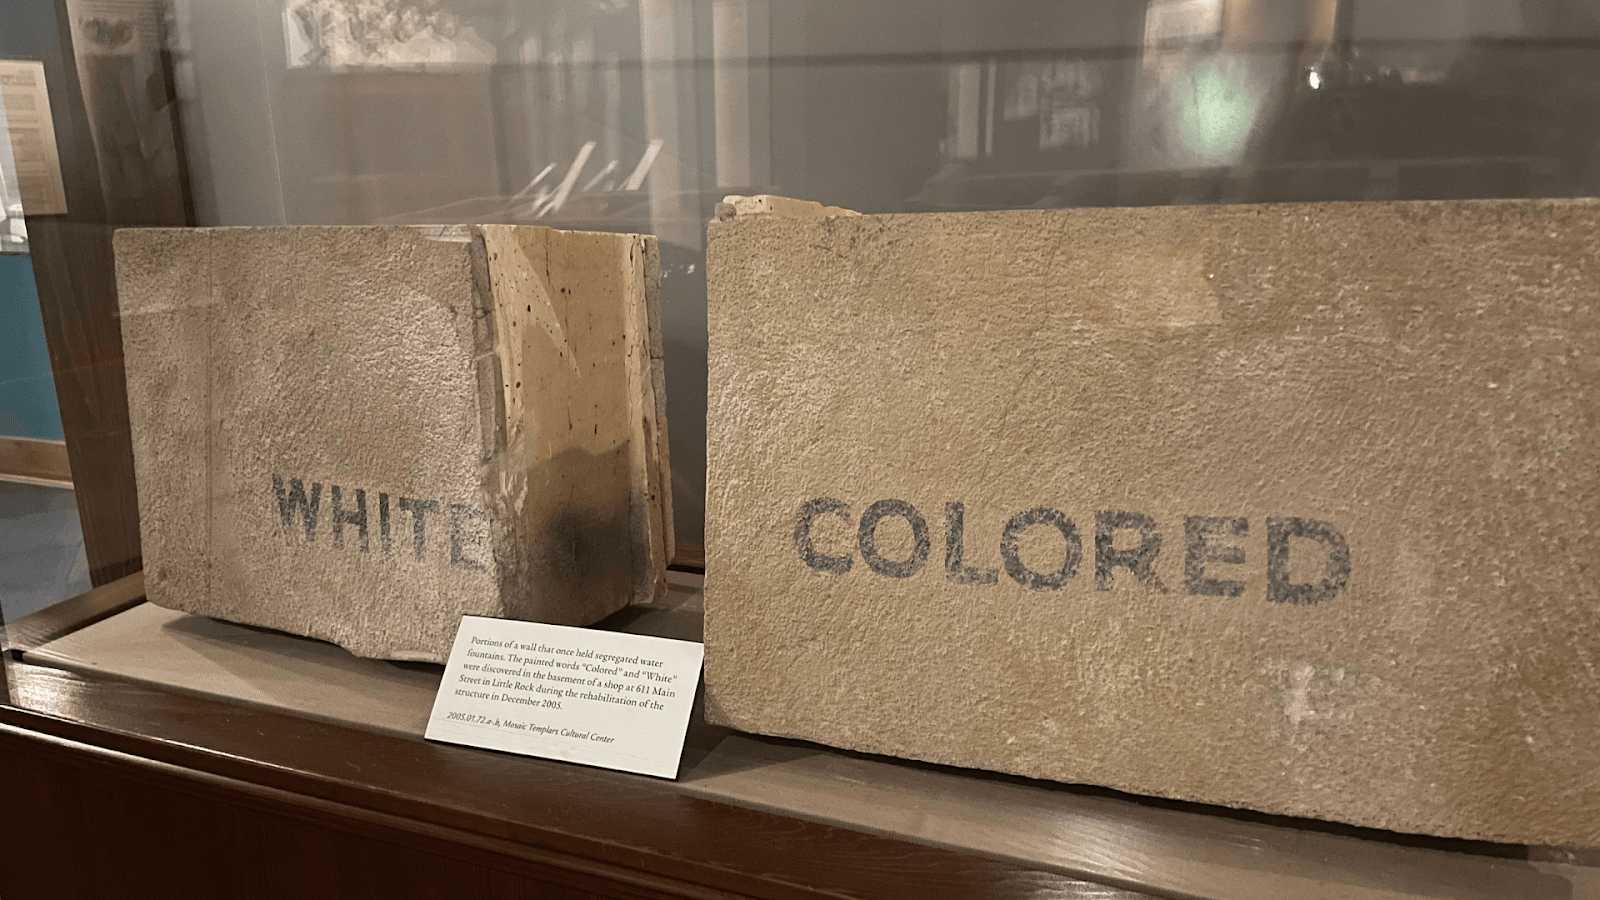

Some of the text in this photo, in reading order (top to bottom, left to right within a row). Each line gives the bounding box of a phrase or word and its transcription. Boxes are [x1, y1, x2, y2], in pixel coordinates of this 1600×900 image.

[272, 473, 491, 574] WHITE
[794, 497, 1351, 604] COLORED
[467, 649, 505, 660] fountains.
[508, 654, 522, 663] The
[523, 657, 554, 667] painted
[556, 661, 580, 670] words
[623, 670, 640, 678] and
[471, 636, 502, 647] Portions
[504, 640, 515, 649] of
[520, 643, 537, 651] wall
[538, 645, 555, 653] that
[576, 649, 593, 658] held
[595, 654, 639, 664] segregated
[640, 659, 664, 667] water
[459, 674, 664, 710] Street in Little Rock during the rehabilitation of the
[464, 663, 480, 671] were
[482, 663, 522, 676] discovered
[523, 669, 531, 677] in
[533, 670, 546, 679] the
[547, 672, 584, 685] basement
[587, 678, 598, 686] of
[604, 680, 624, 692] shop
[636, 685, 650, 694] 611
[652, 687, 675, 697] Main
[455, 689, 563, 710] structure in December 2005.
[503, 720, 526, 730] Mosaic
[529, 724, 559, 735] Templars
[561, 729, 590, 740] Cultural
[590, 733, 615, 744] Center
